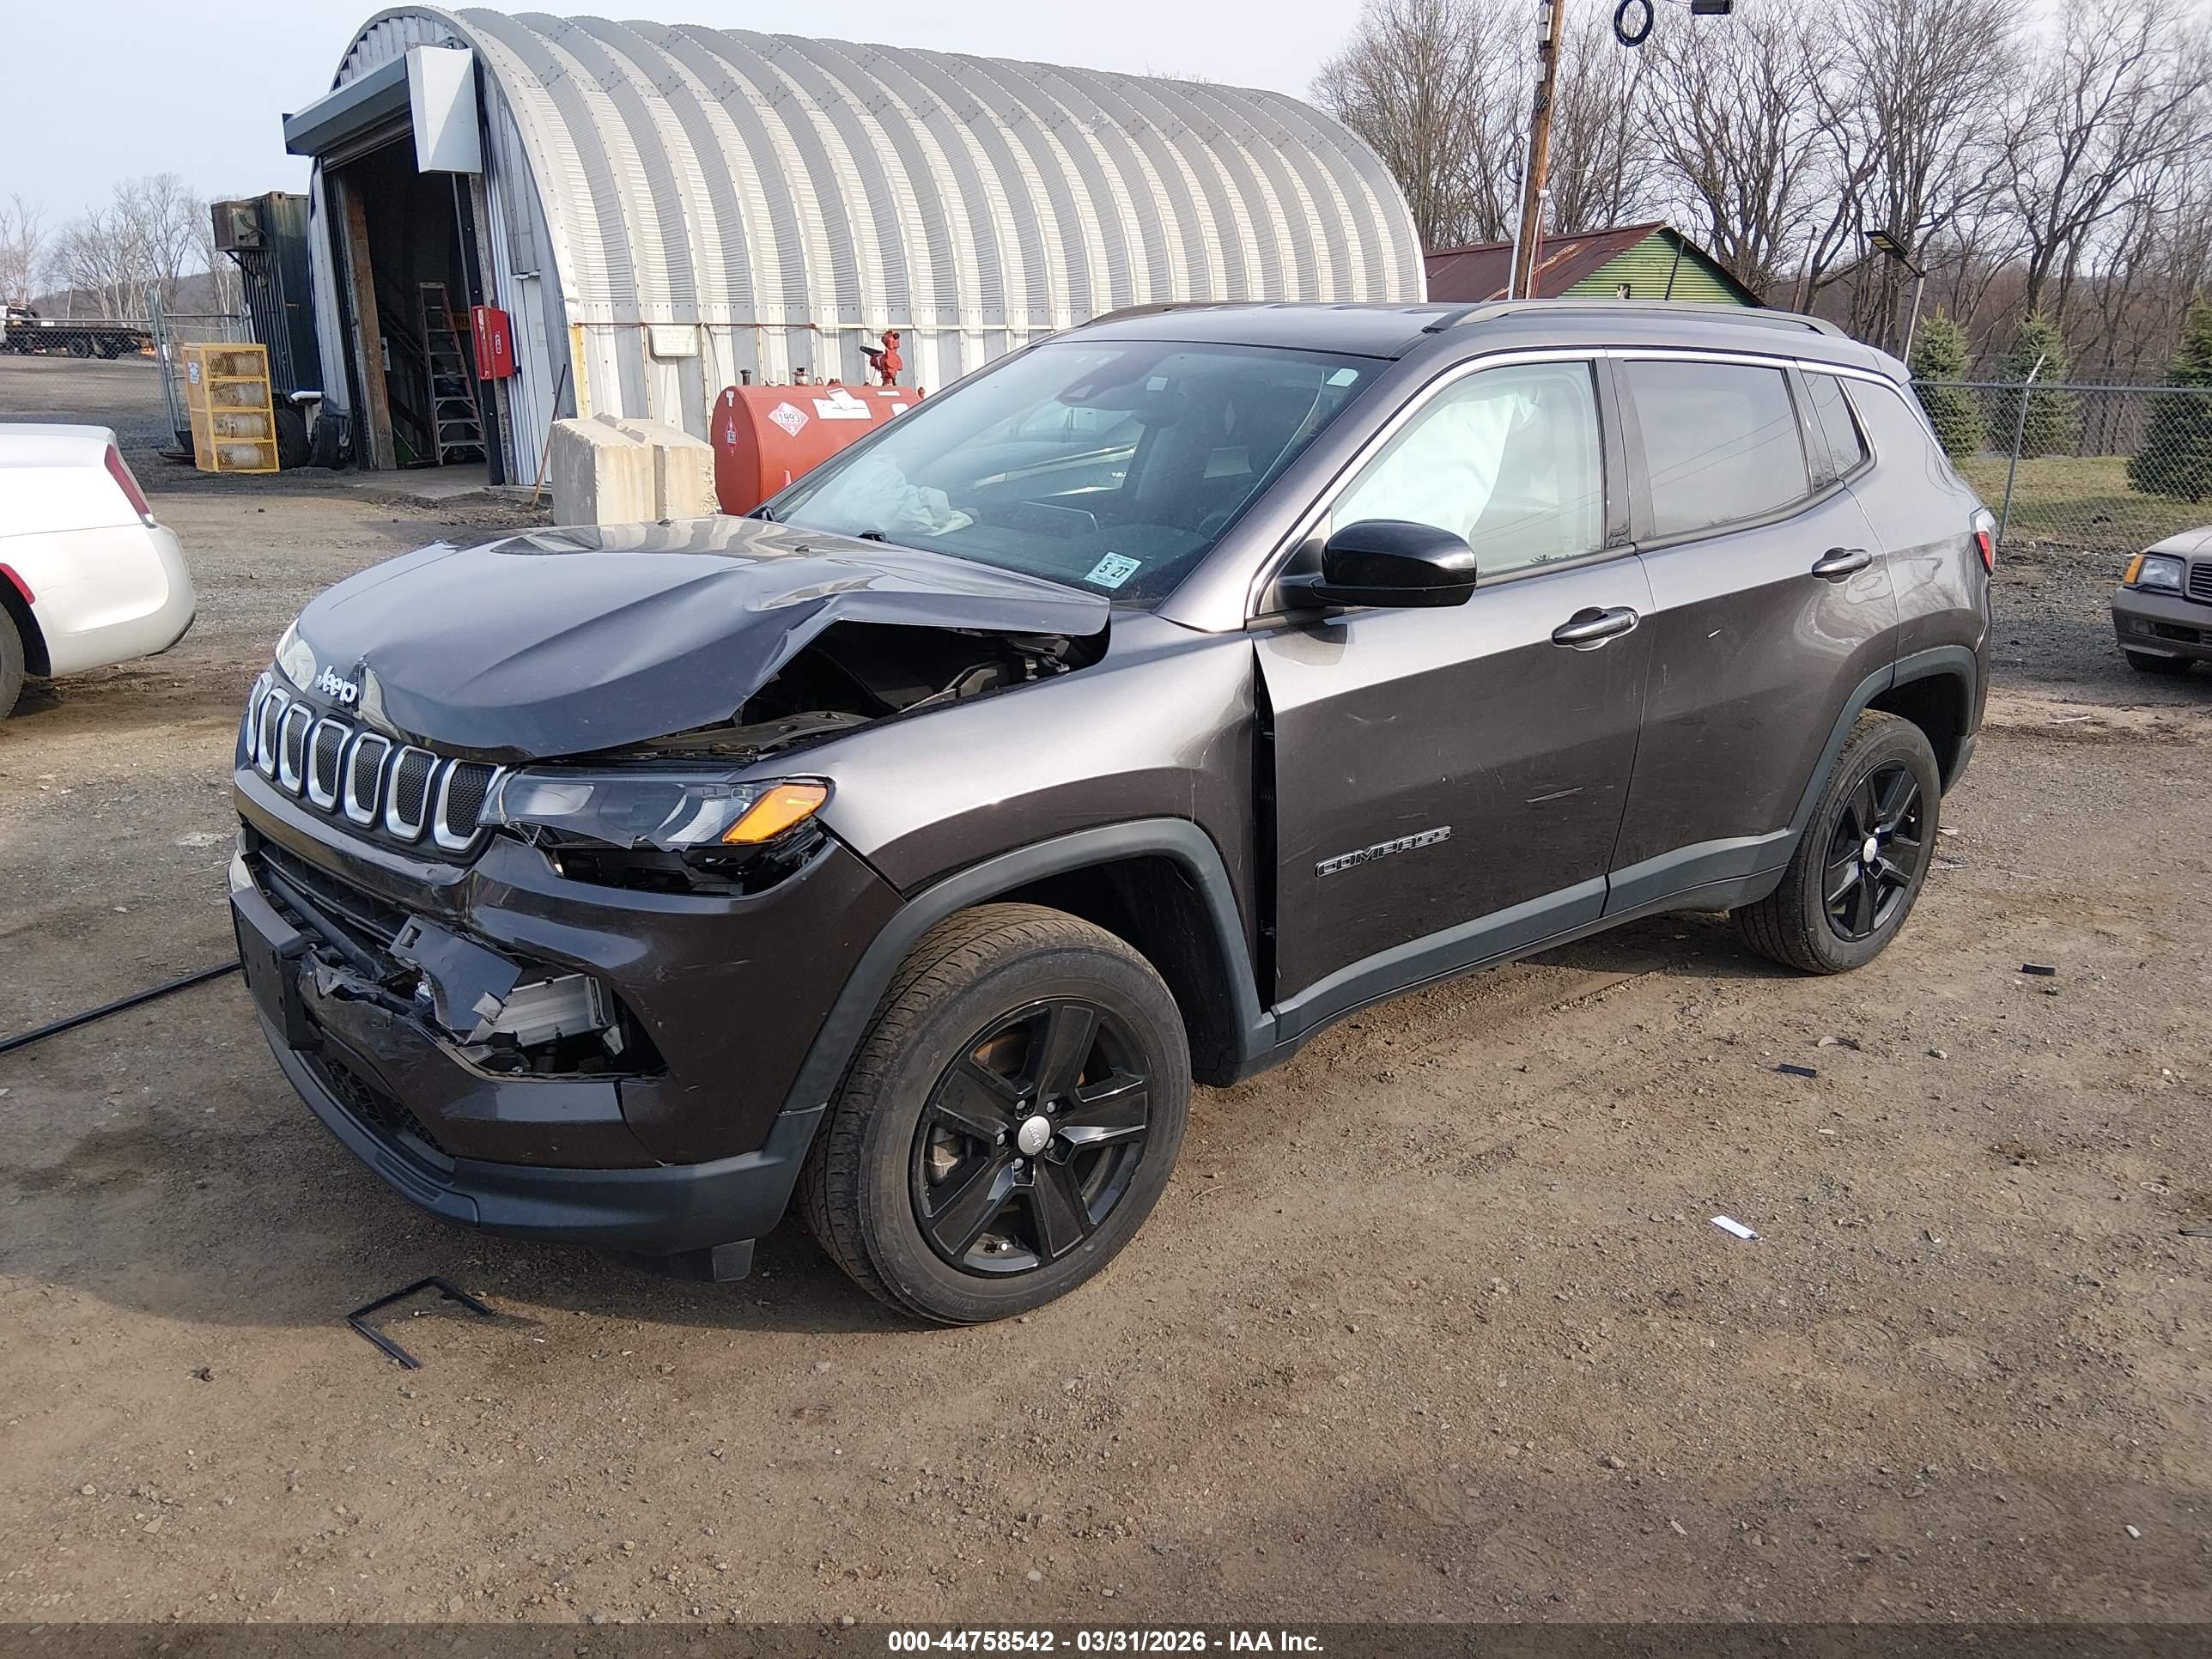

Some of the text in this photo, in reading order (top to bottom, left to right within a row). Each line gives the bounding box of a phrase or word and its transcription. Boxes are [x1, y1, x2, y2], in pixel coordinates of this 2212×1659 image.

[779, 412, 800, 422] 1993
[1098, 562, 1110, 574] 5
[1111, 566, 1130, 579] 27
[315, 665, 358, 703] Jeep
[1315, 825, 1452, 878] COMPASS
